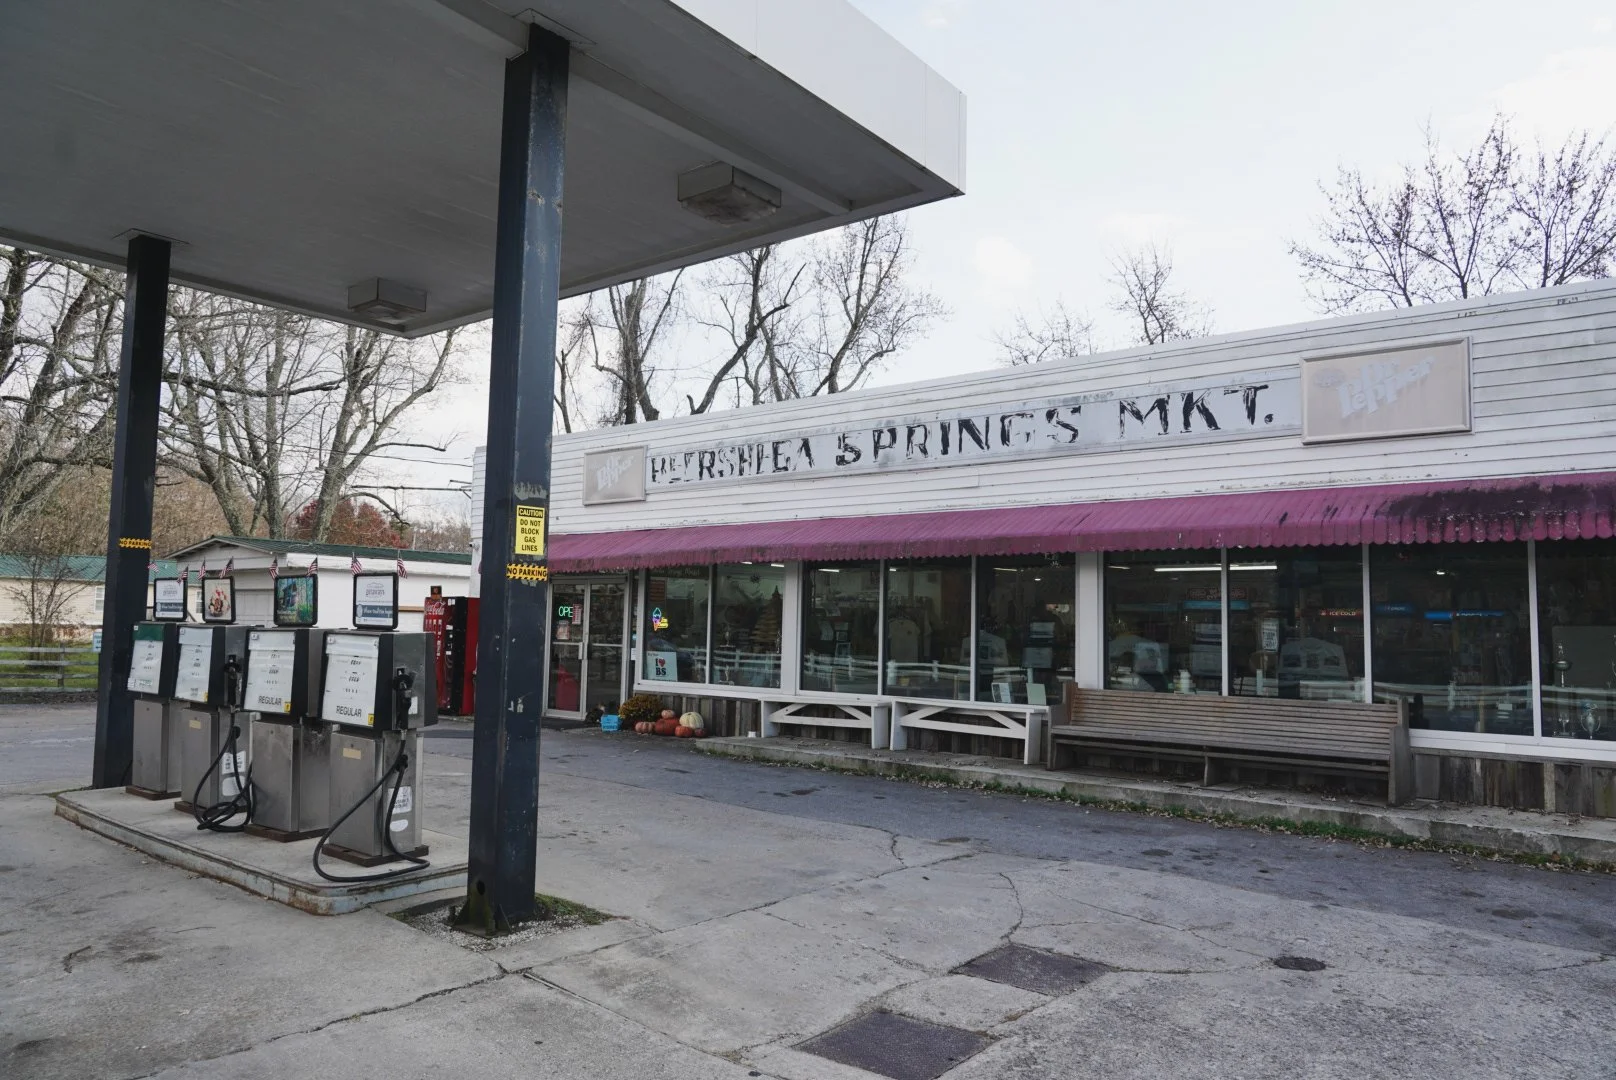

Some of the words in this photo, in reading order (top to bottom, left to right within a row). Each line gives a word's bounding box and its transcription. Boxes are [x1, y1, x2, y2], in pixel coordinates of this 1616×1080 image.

[834, 405, 1082, 467] SPRINGS
[1119, 383, 1275, 439] MKT.
[519, 508, 543, 517] CAUTION
[521, 527, 540, 535] BLOCK
[521, 544, 538, 552] LINES
[507, 567, 517, 575] NO
[519, 568, 547, 577] PARKING
[558, 606, 573, 617] OPE
[257, 695, 282, 706] REGULAR
[336, 705, 362, 718] REGULAR
